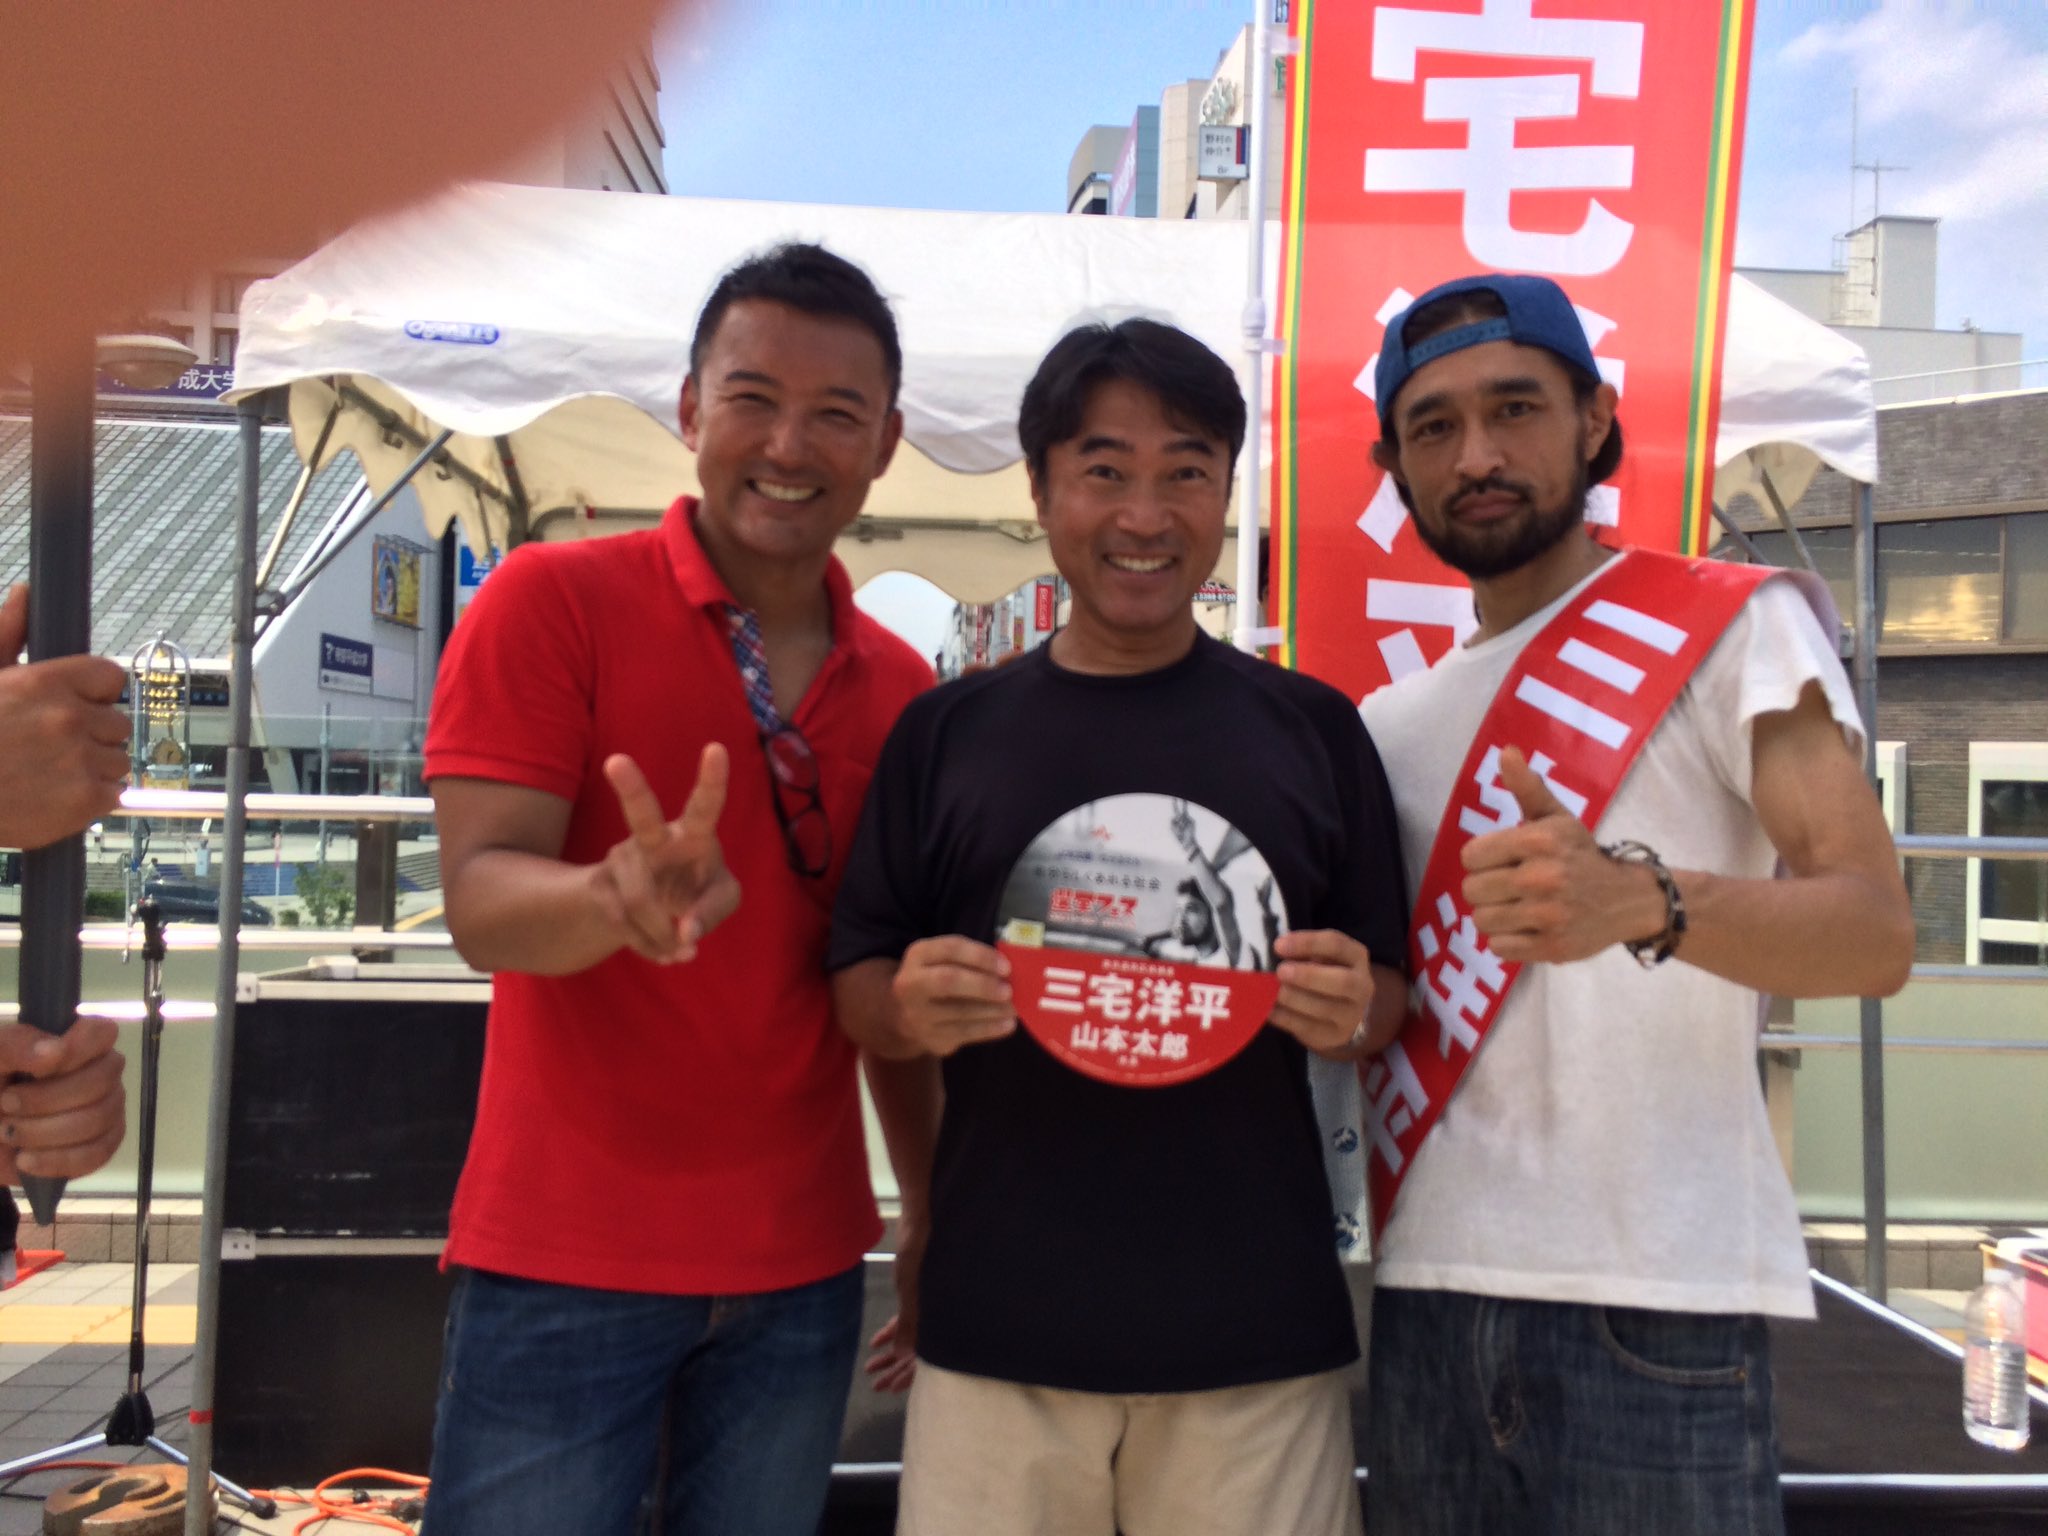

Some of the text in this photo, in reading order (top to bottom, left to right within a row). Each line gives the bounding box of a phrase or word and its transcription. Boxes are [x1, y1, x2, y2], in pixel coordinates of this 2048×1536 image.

[1038, 966, 1231, 1031] 三宅洋平
[1070, 1020, 1189, 1061] 山本太郎
